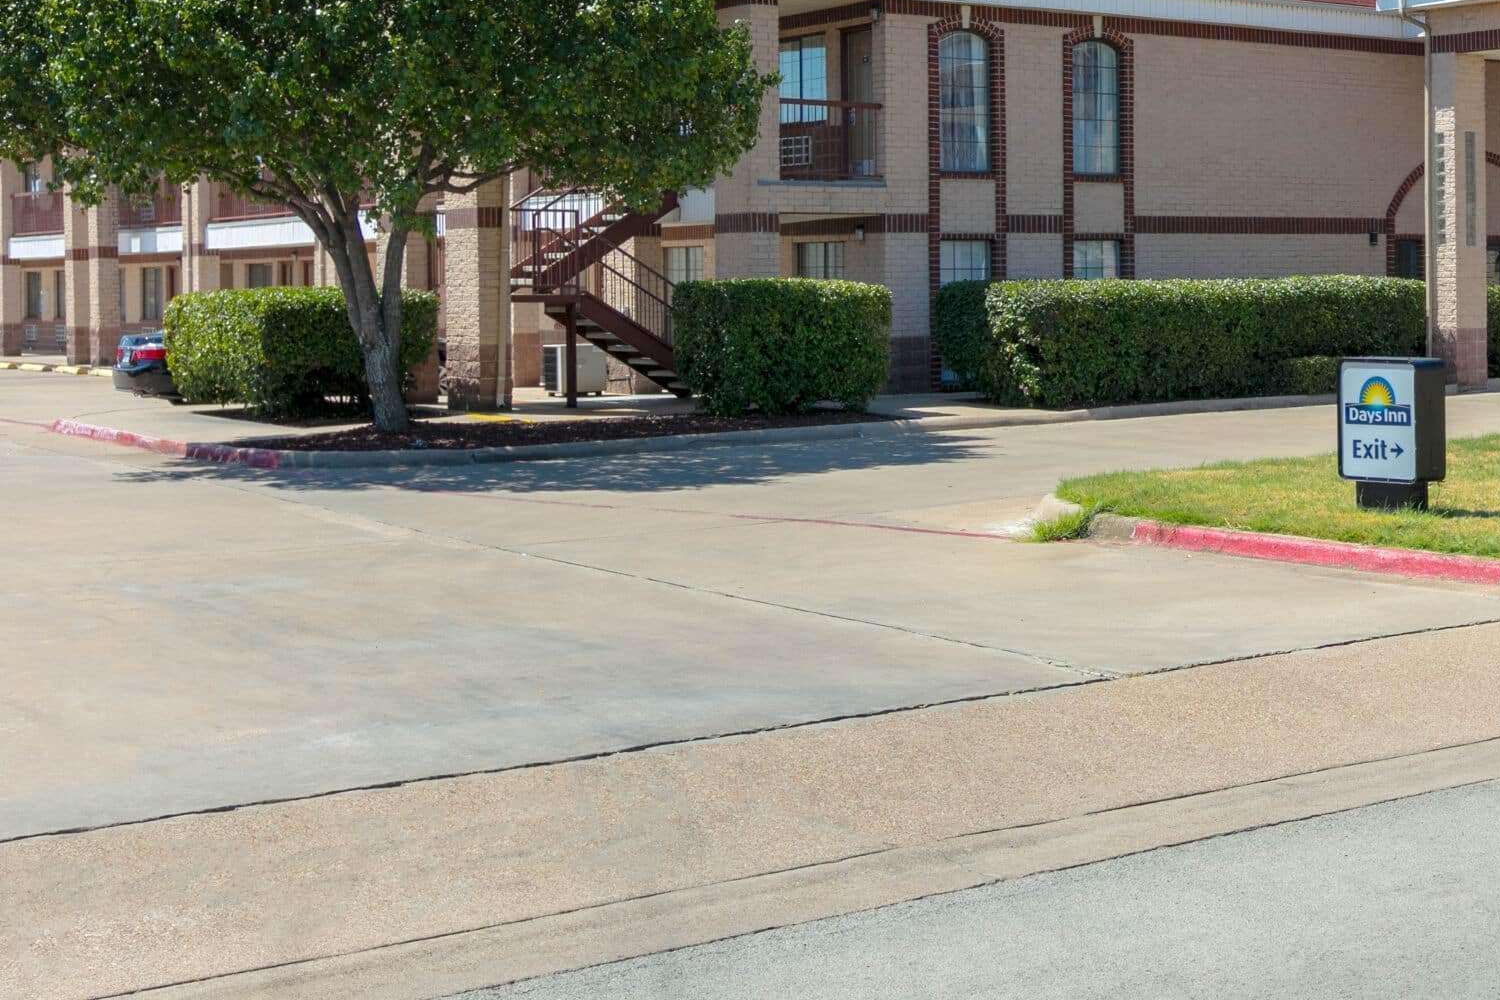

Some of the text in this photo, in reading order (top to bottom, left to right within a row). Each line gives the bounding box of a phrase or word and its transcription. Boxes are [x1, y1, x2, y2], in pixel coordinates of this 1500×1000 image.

[1350, 408, 1407, 423] Days Inn
[1353, 439, 1387, 460] Exit
